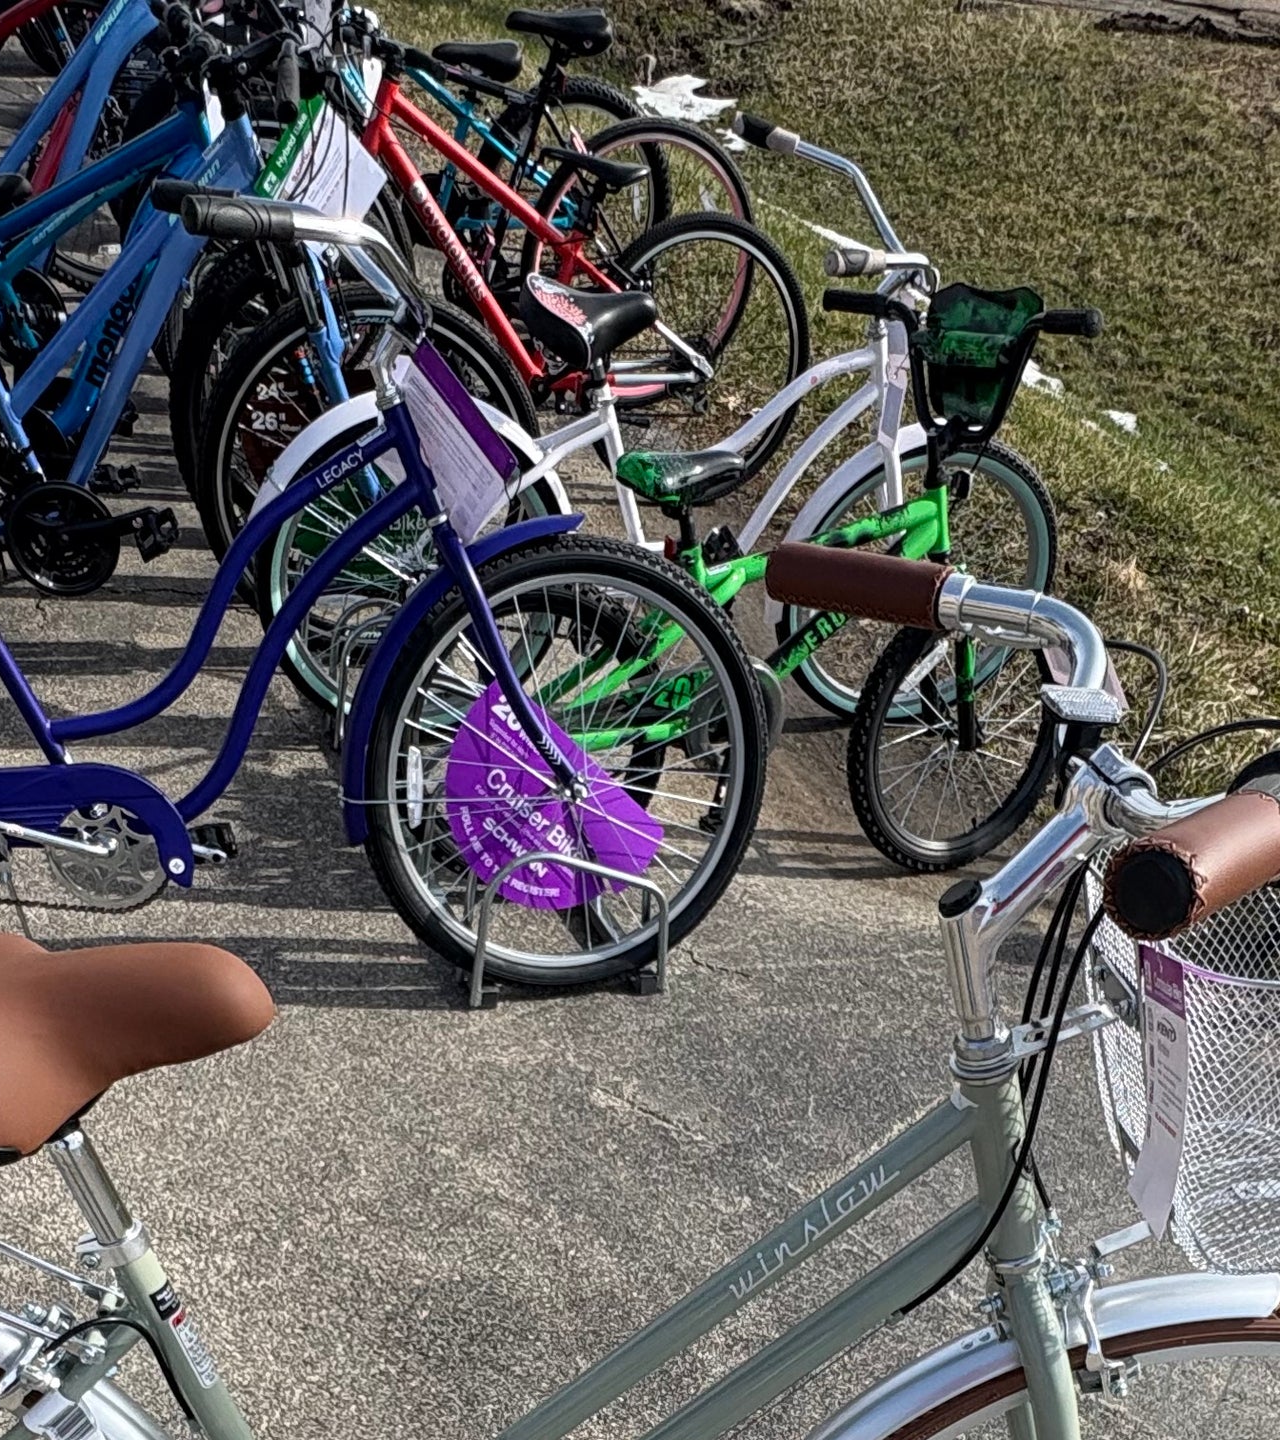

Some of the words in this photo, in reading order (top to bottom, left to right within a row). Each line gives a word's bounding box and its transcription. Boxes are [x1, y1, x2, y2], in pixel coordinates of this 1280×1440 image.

[275, 134, 297, 169] Hybrid
[251, 410, 286, 431] 26"
[314, 448, 365, 490] LEGACY
[486, 768, 551, 832] Cruiser
[459, 805, 475, 837] ROLL
[480, 851, 495, 868] TO
[482, 816, 550, 879] SCHWNN
[728, 1163, 901, 1300] winslow
